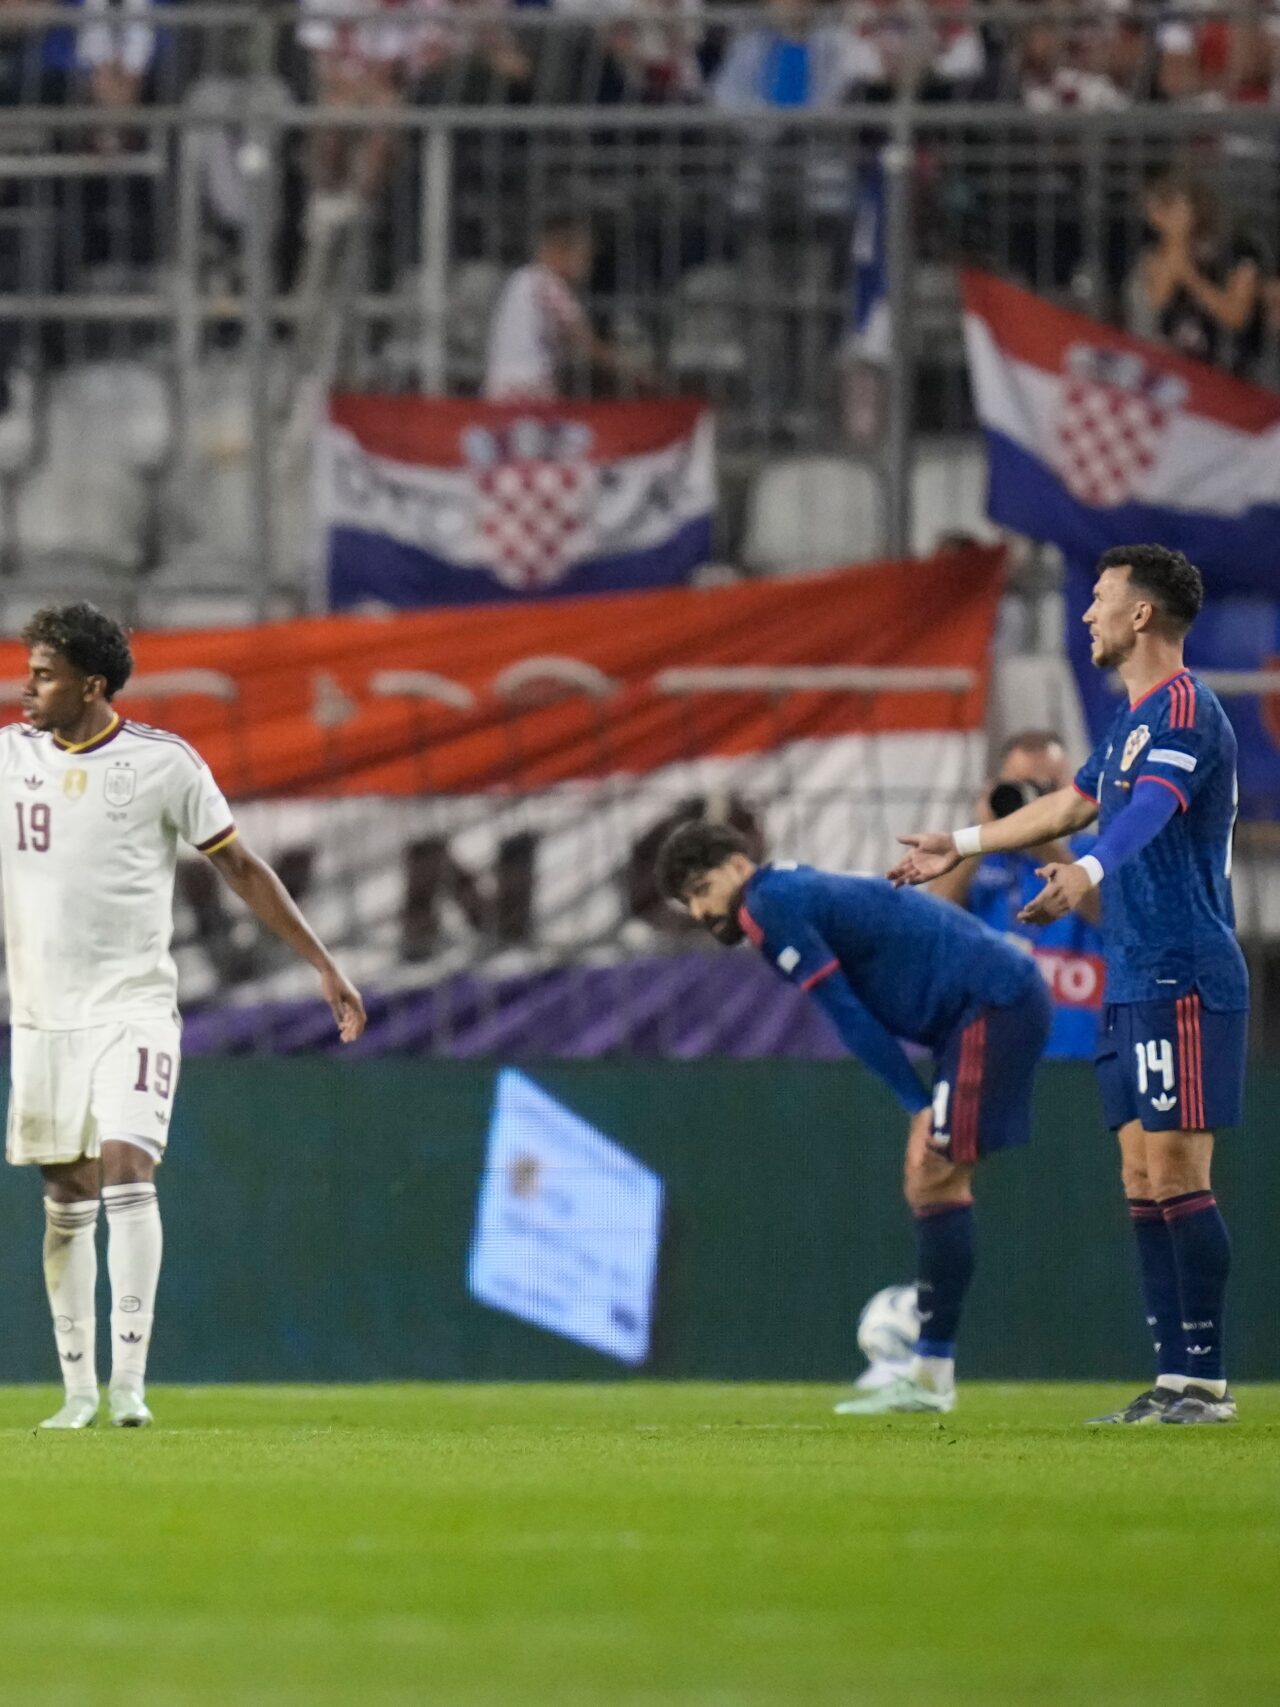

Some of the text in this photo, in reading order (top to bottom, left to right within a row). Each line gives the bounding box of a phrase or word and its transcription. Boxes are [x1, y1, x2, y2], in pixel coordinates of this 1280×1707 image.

[15, 801, 51, 853] 19
[133, 1046, 173, 1099] 19
[1135, 1038, 1175, 1093] 14
